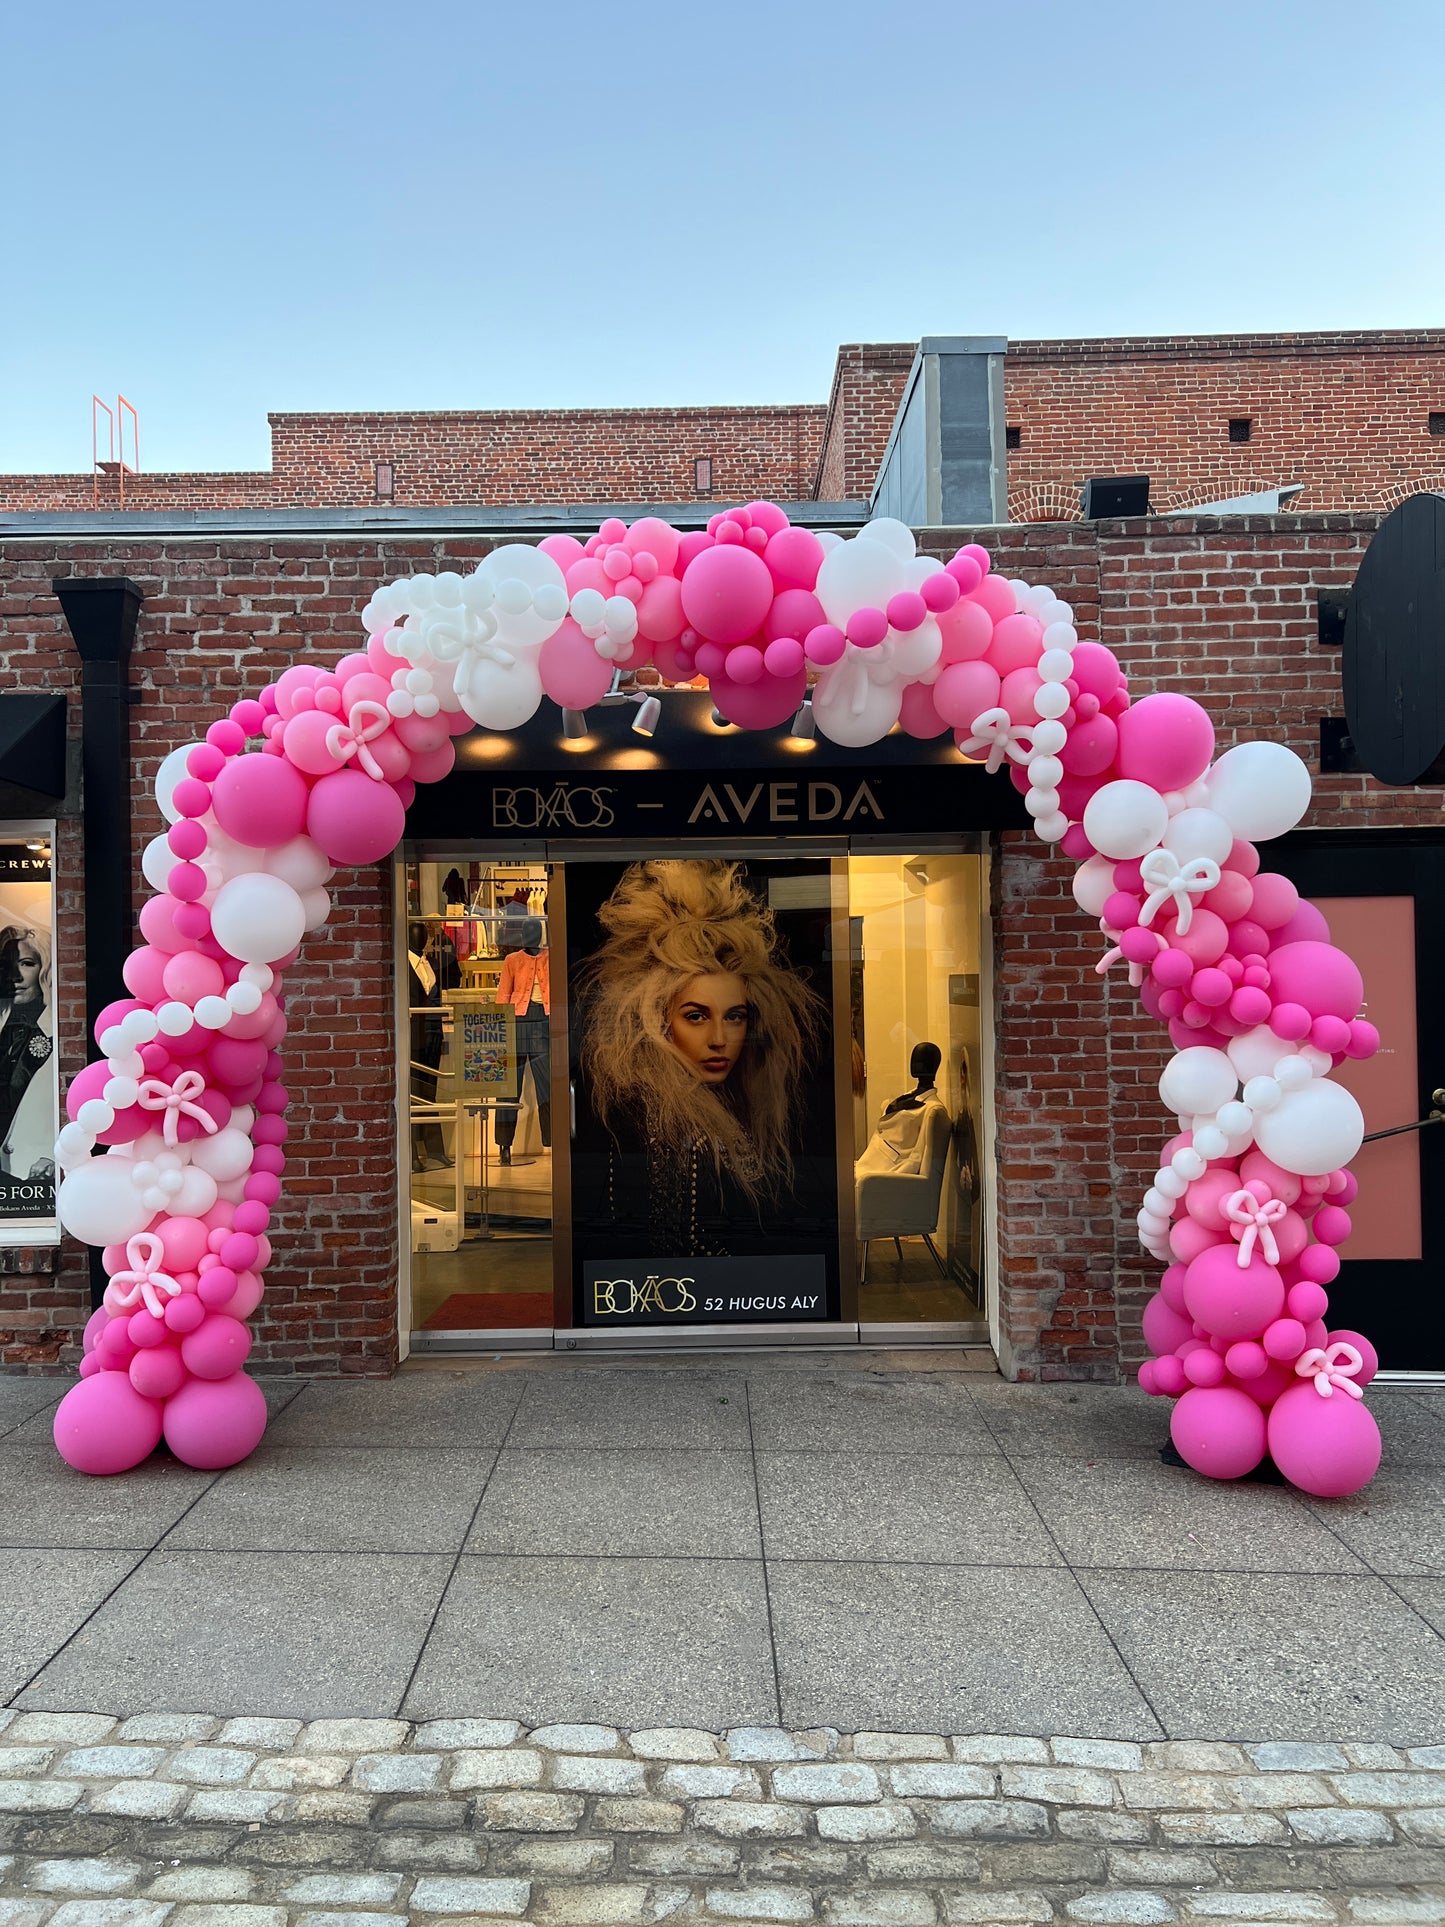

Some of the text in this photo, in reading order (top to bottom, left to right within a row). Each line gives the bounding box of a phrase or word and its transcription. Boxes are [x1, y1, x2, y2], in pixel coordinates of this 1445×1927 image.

[463, 1013, 506, 1028] TOGETHER
[483, 1021, 507, 1032] WE
[464, 1028, 507, 1043] SHINE
[10, 1185, 45, 1200] FOR
[703, 1297, 724, 1311] 52
[729, 1296, 786, 1310] HUGUS
[791, 1295, 819, 1309] ALY
